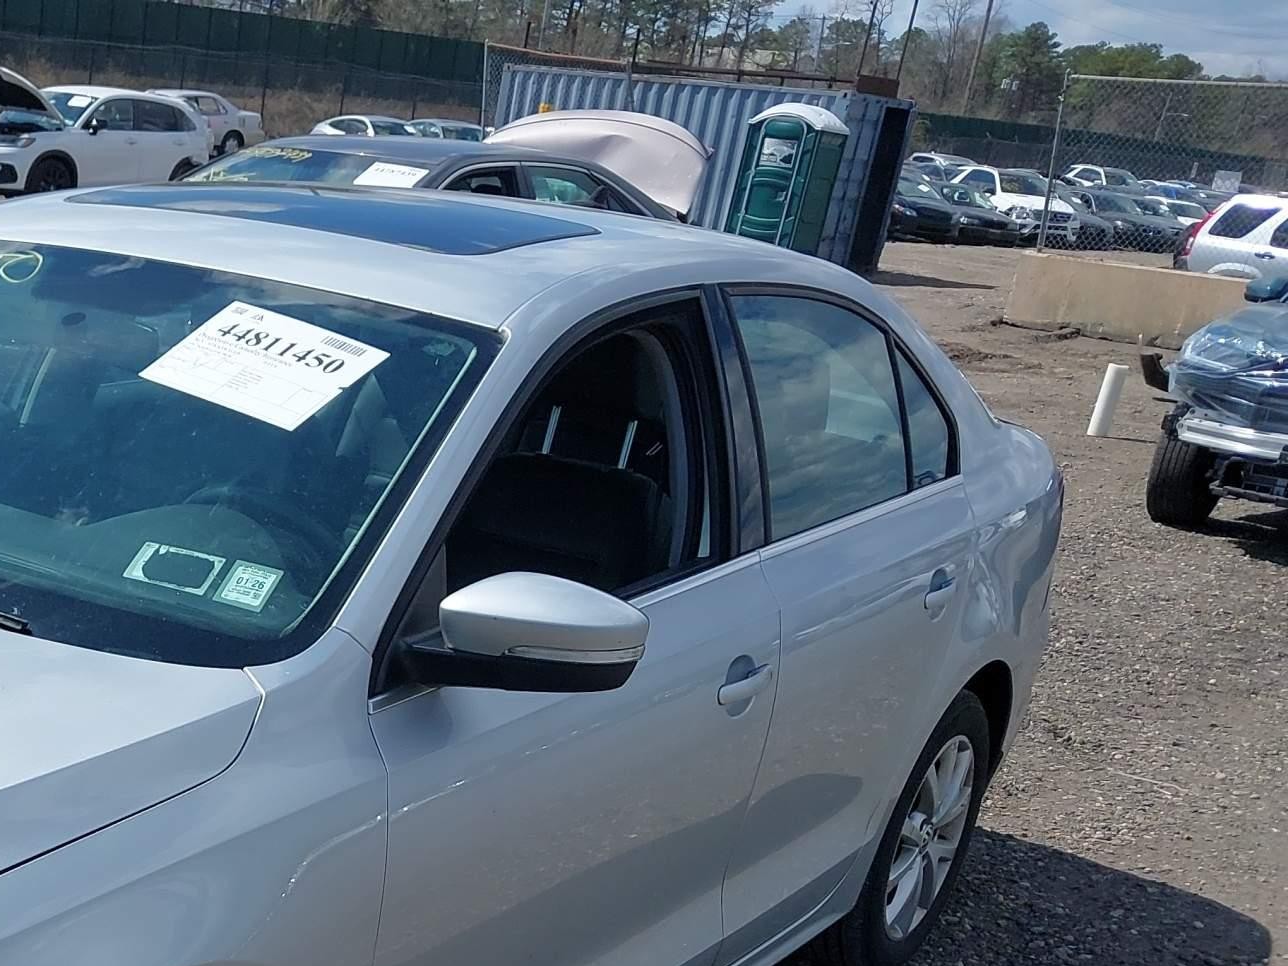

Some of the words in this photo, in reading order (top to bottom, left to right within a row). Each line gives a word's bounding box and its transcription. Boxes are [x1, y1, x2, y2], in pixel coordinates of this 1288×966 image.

[217, 323, 345, 374] 44811450
[236, 576, 249, 585] 01
[251, 579, 266, 589] 26
